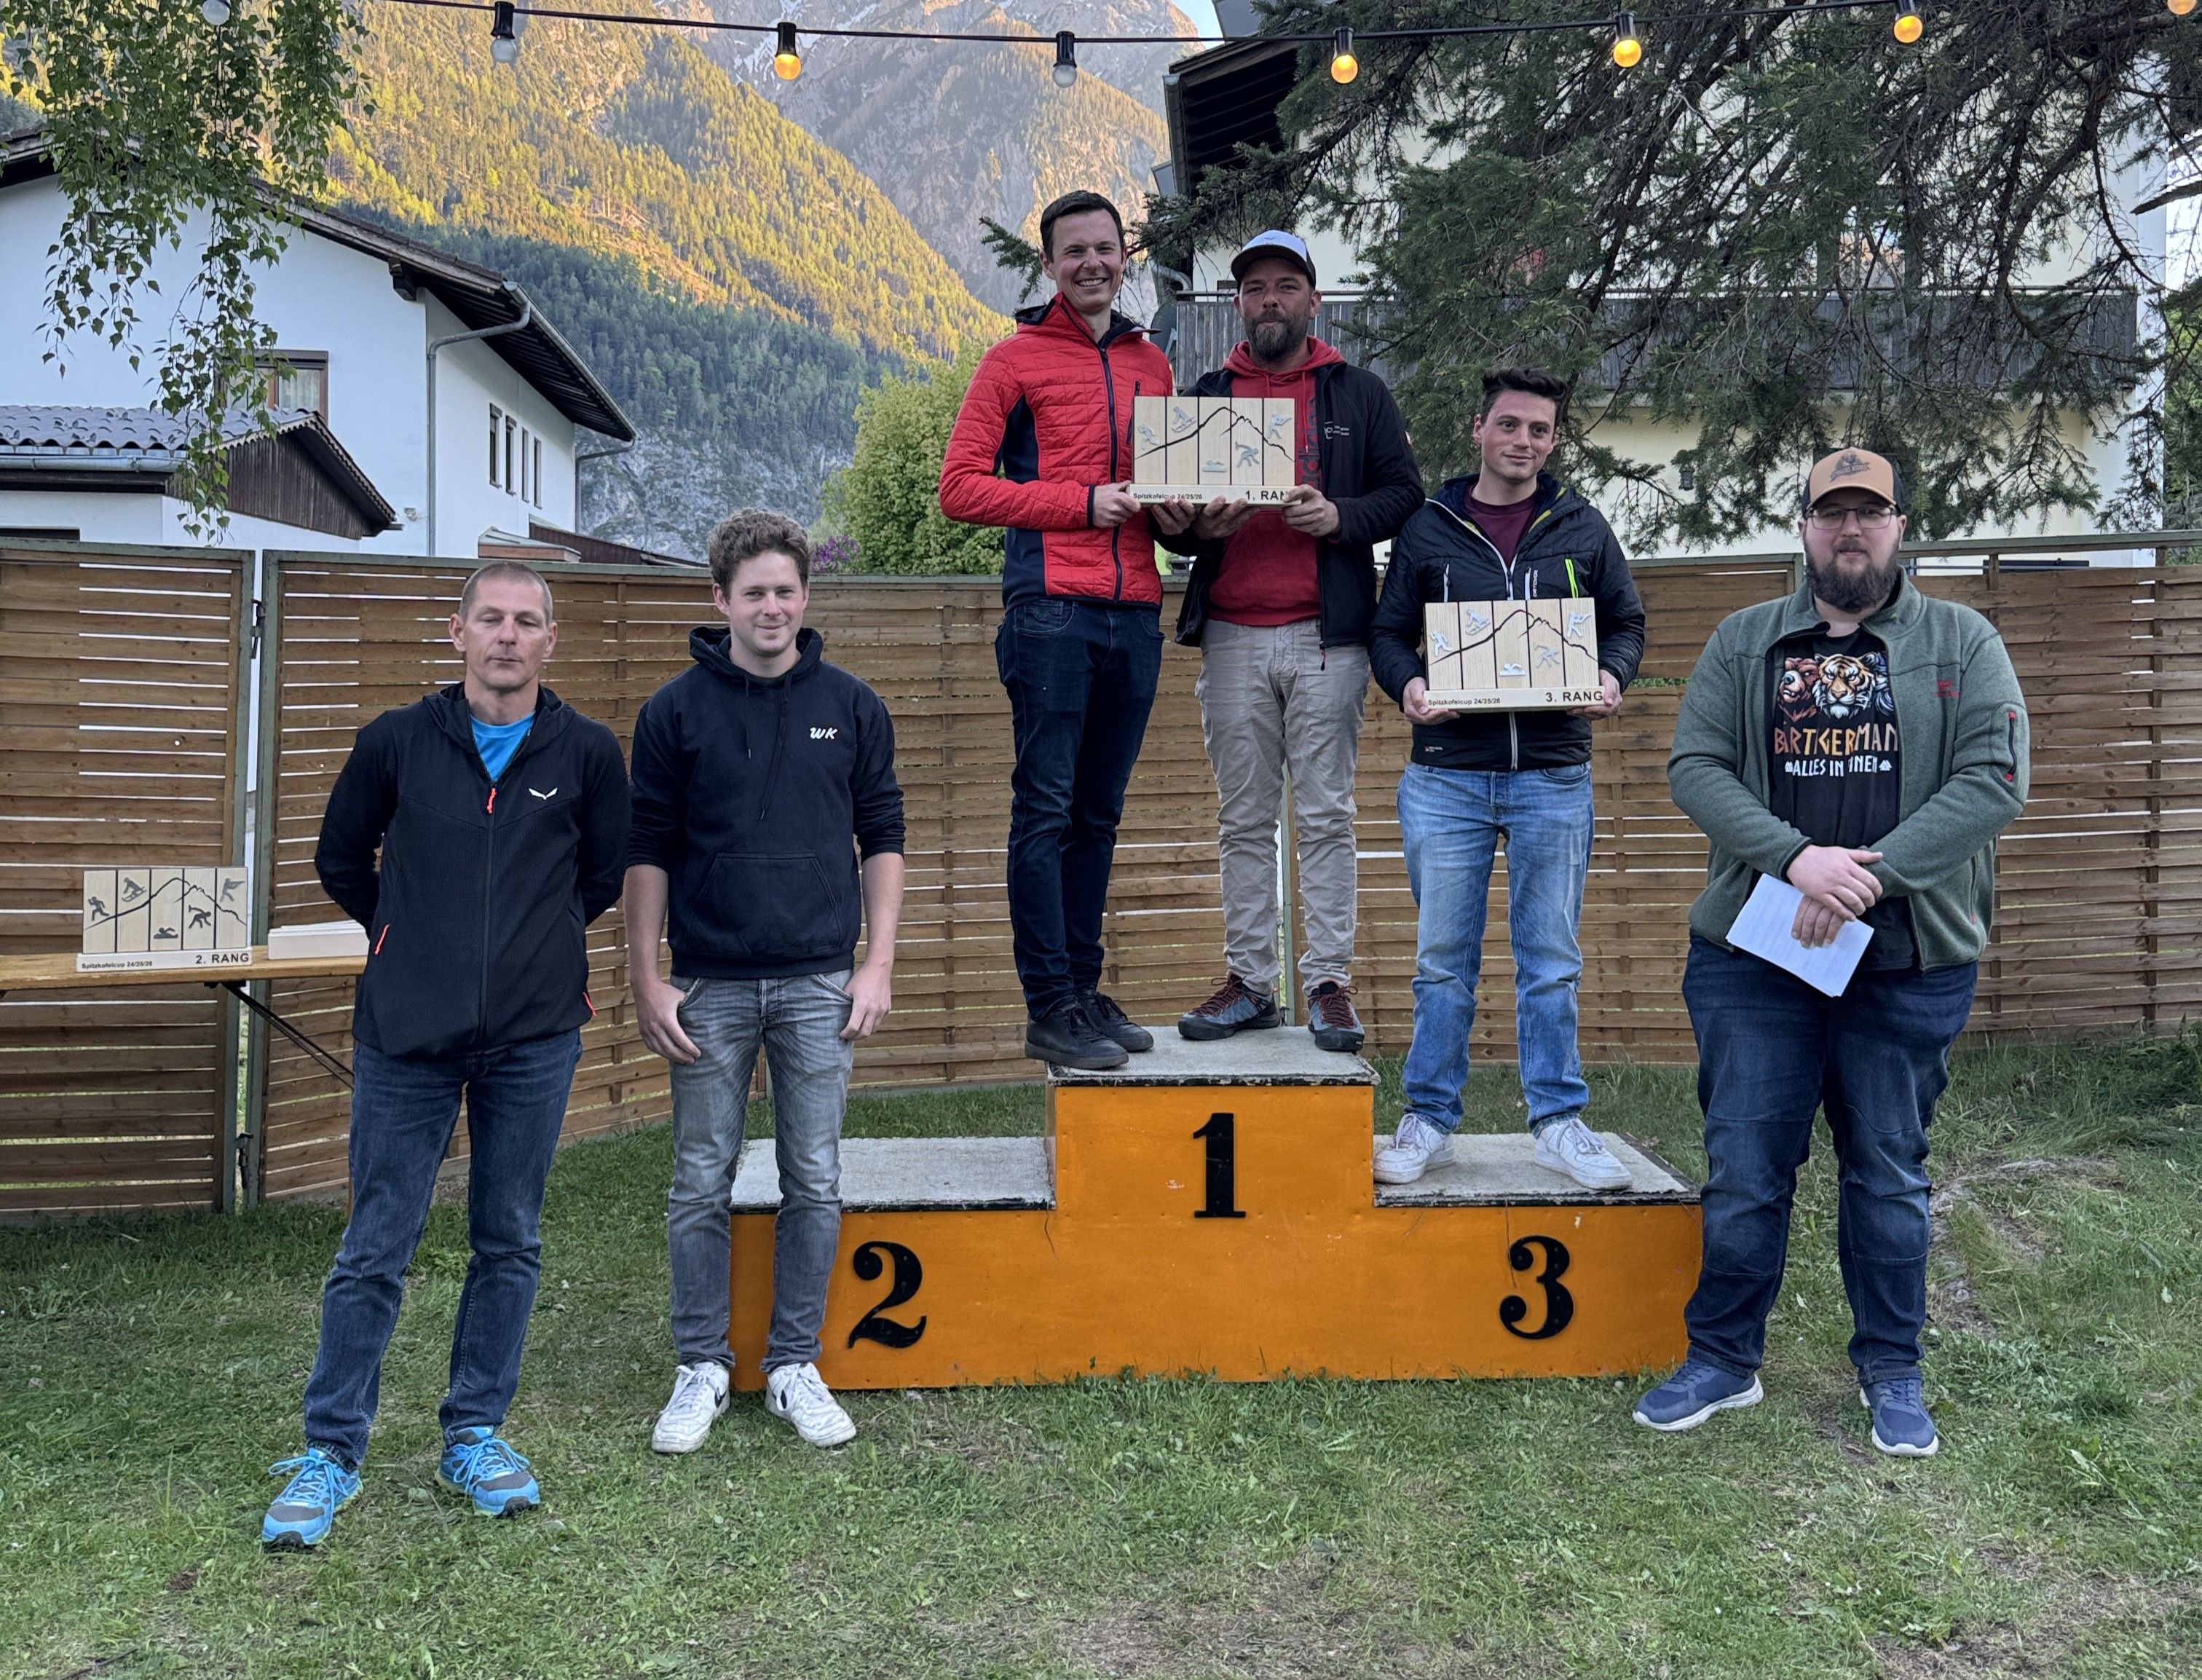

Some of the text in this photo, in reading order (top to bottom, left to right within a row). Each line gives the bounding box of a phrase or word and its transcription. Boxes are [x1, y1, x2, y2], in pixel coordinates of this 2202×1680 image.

[1246, 490, 1288, 500] 1. RAN
[1545, 691, 1603, 703] 3. RANG
[810, 727, 838, 740] WK
[1792, 758, 1826, 777] ALLES
[1829, 760, 1844, 777] IN
[195, 953, 249, 964] 2. RANG
[1193, 1113, 1247, 1218] 1
[847, 1241, 927, 1349] 2
[1499, 1235, 1574, 1340] 3
